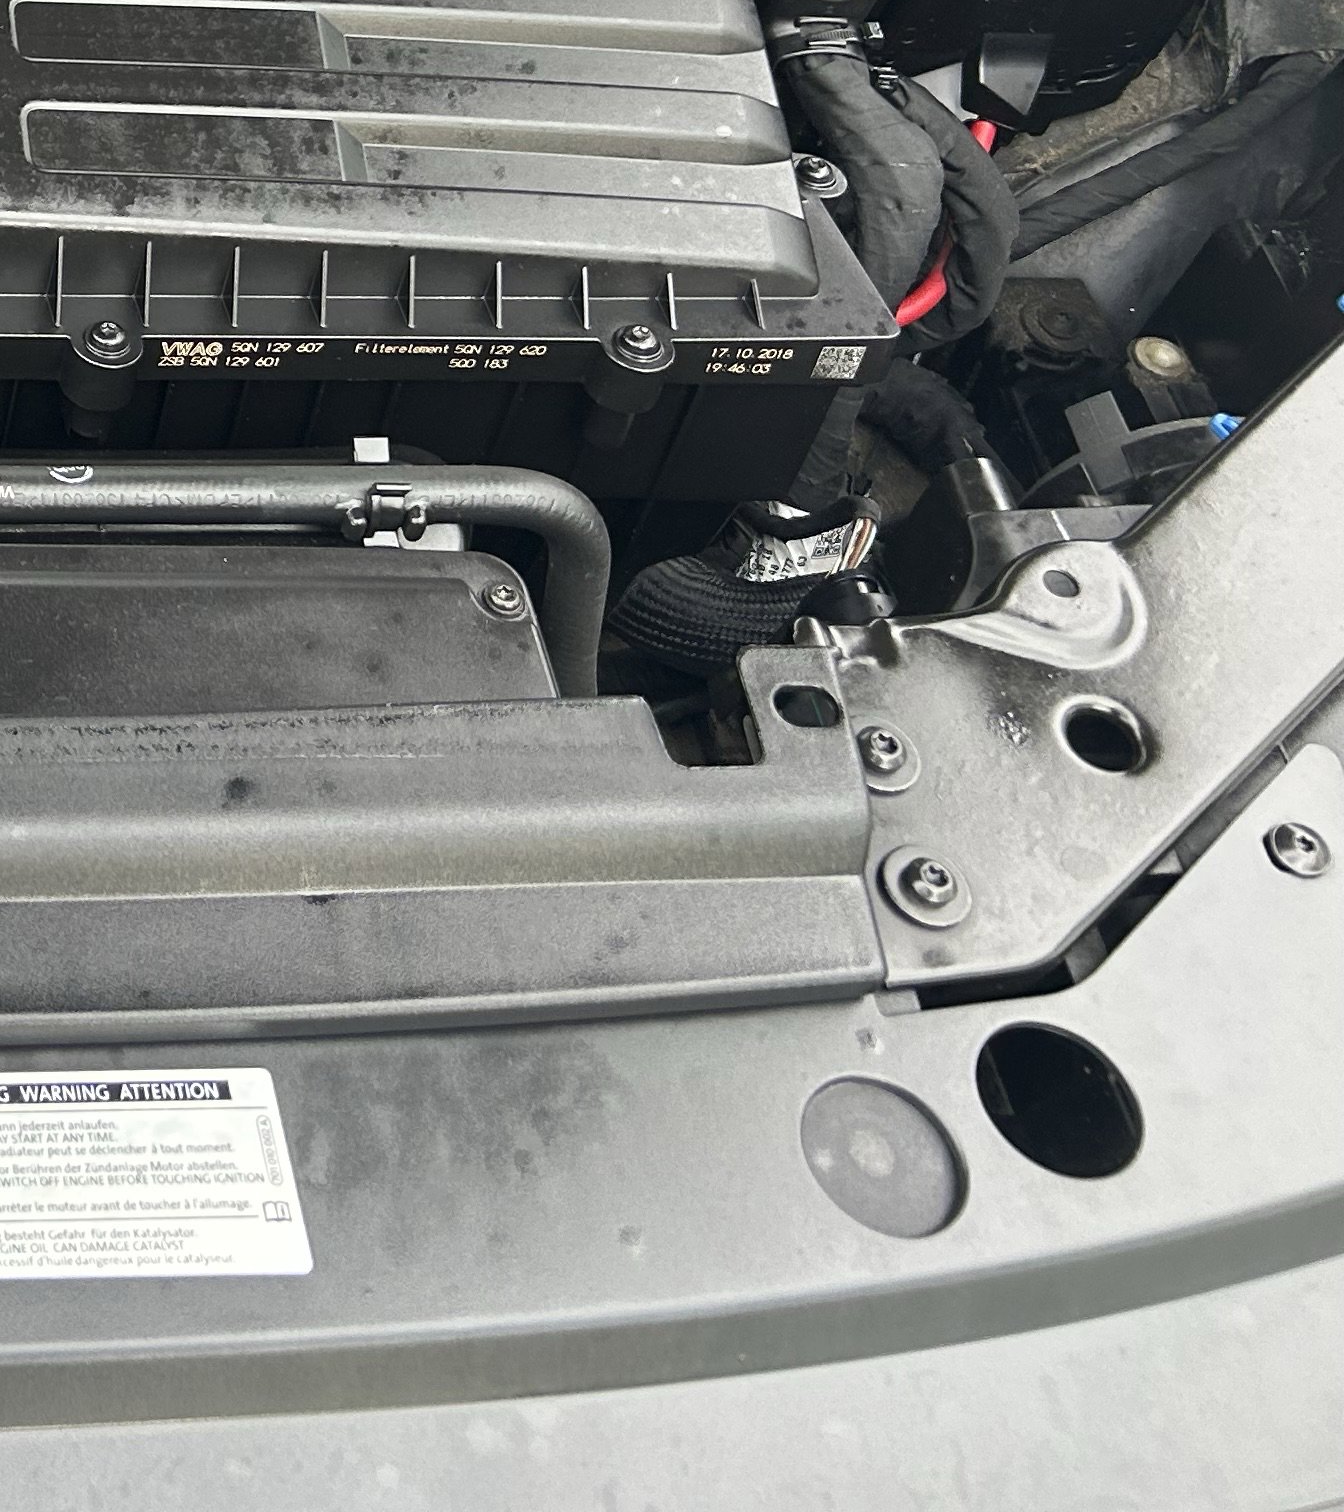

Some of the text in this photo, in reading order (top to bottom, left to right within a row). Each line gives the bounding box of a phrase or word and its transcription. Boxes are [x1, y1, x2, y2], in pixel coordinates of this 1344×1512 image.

[230, 342, 260, 353] 5QN
[266, 342, 292, 353] 129
[296, 342, 325, 353] 607
[355, 343, 547, 356] Filterelement 5QN 129 620
[157, 356, 280, 367] ZSB 5QN 129 601
[483, 358, 510, 369] 183
[20, 1083, 109, 1104] WARNING
[118, 1080, 218, 1100] ATTENTION
[11, 1132, 42, 1144] START
[46, 1132, 58, 1143] AT
[62, 1132, 84, 1142] ANY
[62, 1175, 104, 1186] ENGINE
[29, 1242, 48, 1253] OIL
[53, 1242, 77, 1252] CAN
